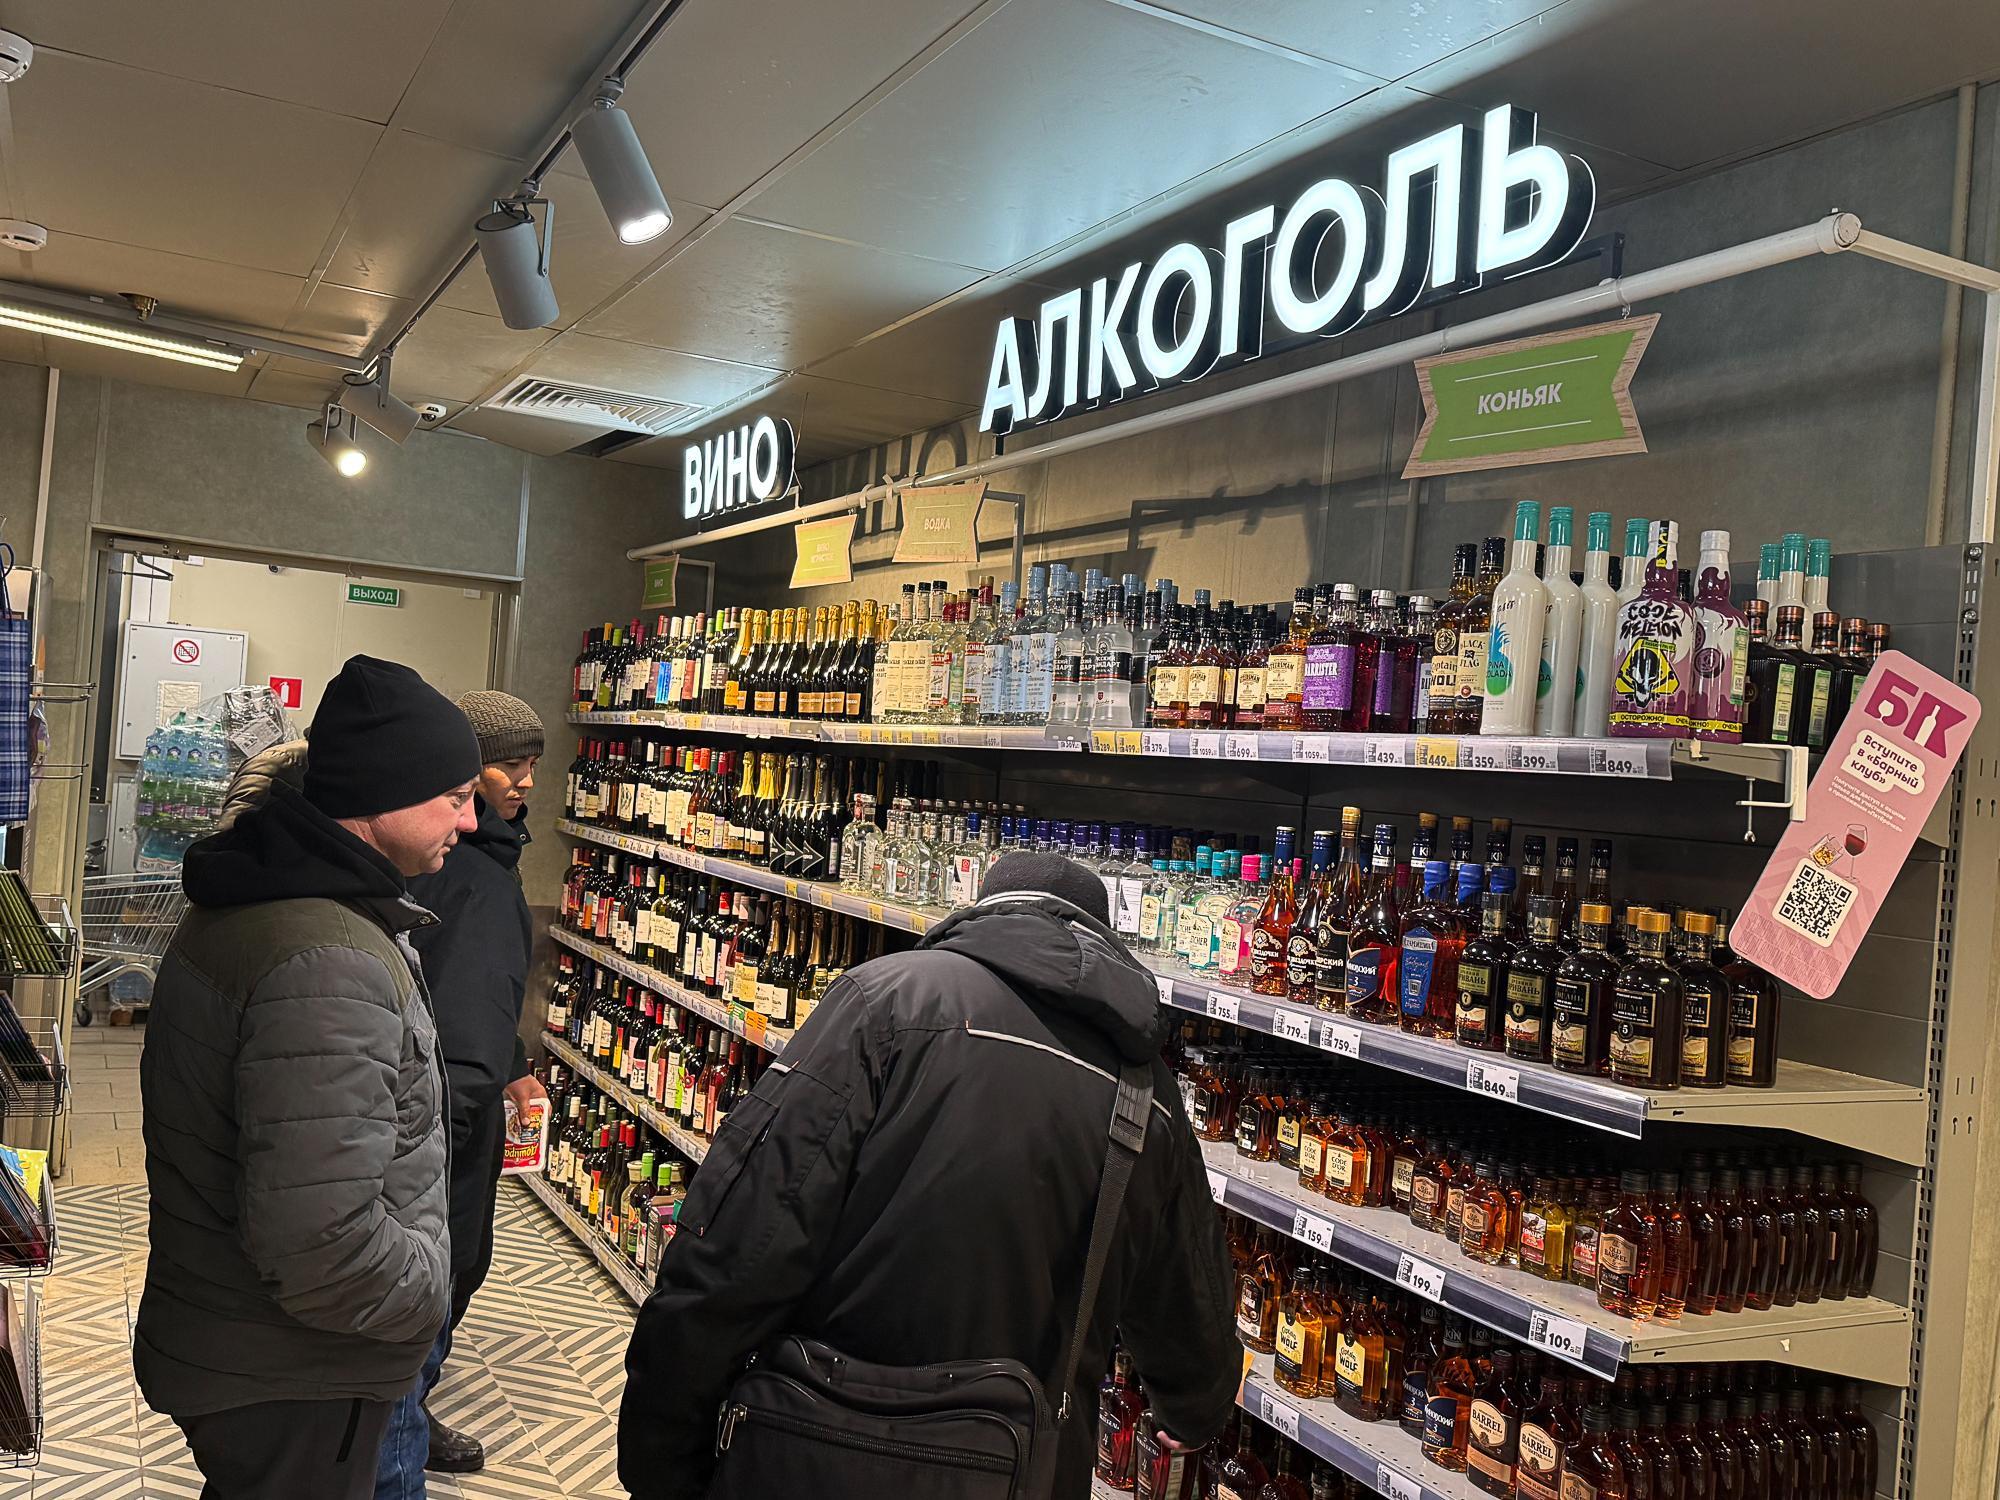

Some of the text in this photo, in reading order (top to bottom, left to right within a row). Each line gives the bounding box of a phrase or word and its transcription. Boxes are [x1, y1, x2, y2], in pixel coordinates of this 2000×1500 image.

[978, 102, 1571, 435] АЛКОГОЛЬ
[1476, 381, 1563, 416] КОНЬЯК
[684, 415, 779, 520] ВИНО
[924, 517, 951, 531] ВОДКА
[353, 588, 393, 603] ВЫХОД
[1377, 752, 1395, 763] 439
[1863, 734, 1918, 773] Вступите
[1428, 755, 1447, 767] 449
[1475, 756, 1494, 768] 359
[1523, 756, 1545, 768] 399
[1607, 760, 1632, 773] 849
[1857, 748, 1919, 788] в «Барный
[1850, 760, 1886, 784] клуб»
[1317, 970, 1323, 979] 6
[1354, 976, 1359, 986] 3
[1463, 994, 1468, 1002] 7
[1218, 1006, 1231, 1018] 755
[1516, 1005, 1521, 1013] 7
[1559, 1012, 1565, 1021] 5
[1286, 1025, 1300, 1038] 779
[1622, 1024, 1629, 1034] 5
[1334, 1039, 1350, 1052] 759
[1484, 1080, 1506, 1096] 849
[504, 1144, 539, 1158] Дошира
[1331, 1157, 1347, 1166] CODE
[1308, 1229, 1322, 1244] 159
[1413, 1274, 1431, 1292] 199
[1280, 1332, 1298, 1350] WOLF
[1549, 1332, 1571, 1351] 109
[1339, 1353, 1358, 1372] WOLF
[1275, 1416, 1289, 1430] 419
[1433, 1423, 1438, 1432] 3
[1472, 1409, 1503, 1434] BARREL
[1521, 1433, 1554, 1459] BARREL
